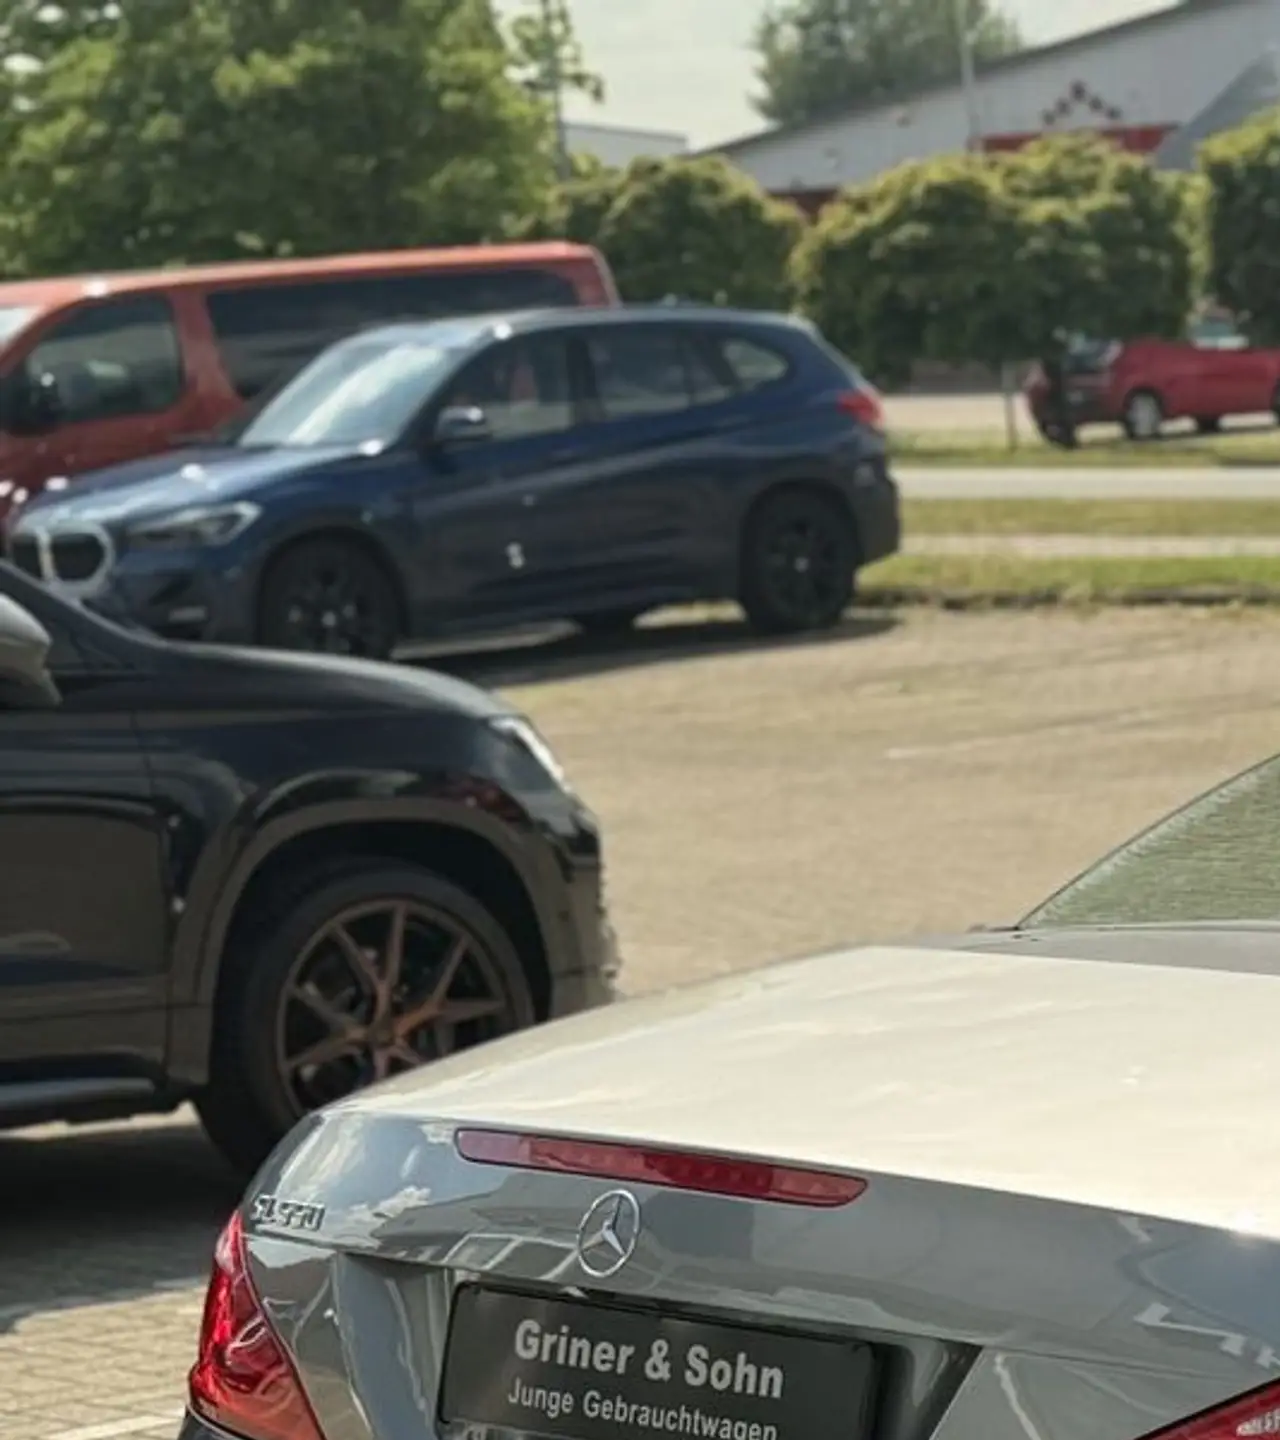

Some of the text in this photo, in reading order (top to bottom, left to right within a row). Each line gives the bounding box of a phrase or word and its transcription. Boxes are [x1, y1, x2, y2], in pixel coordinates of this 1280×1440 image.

[514, 1318, 784, 1399] Griner & Sohn
[507, 1376, 575, 1420] Junge
